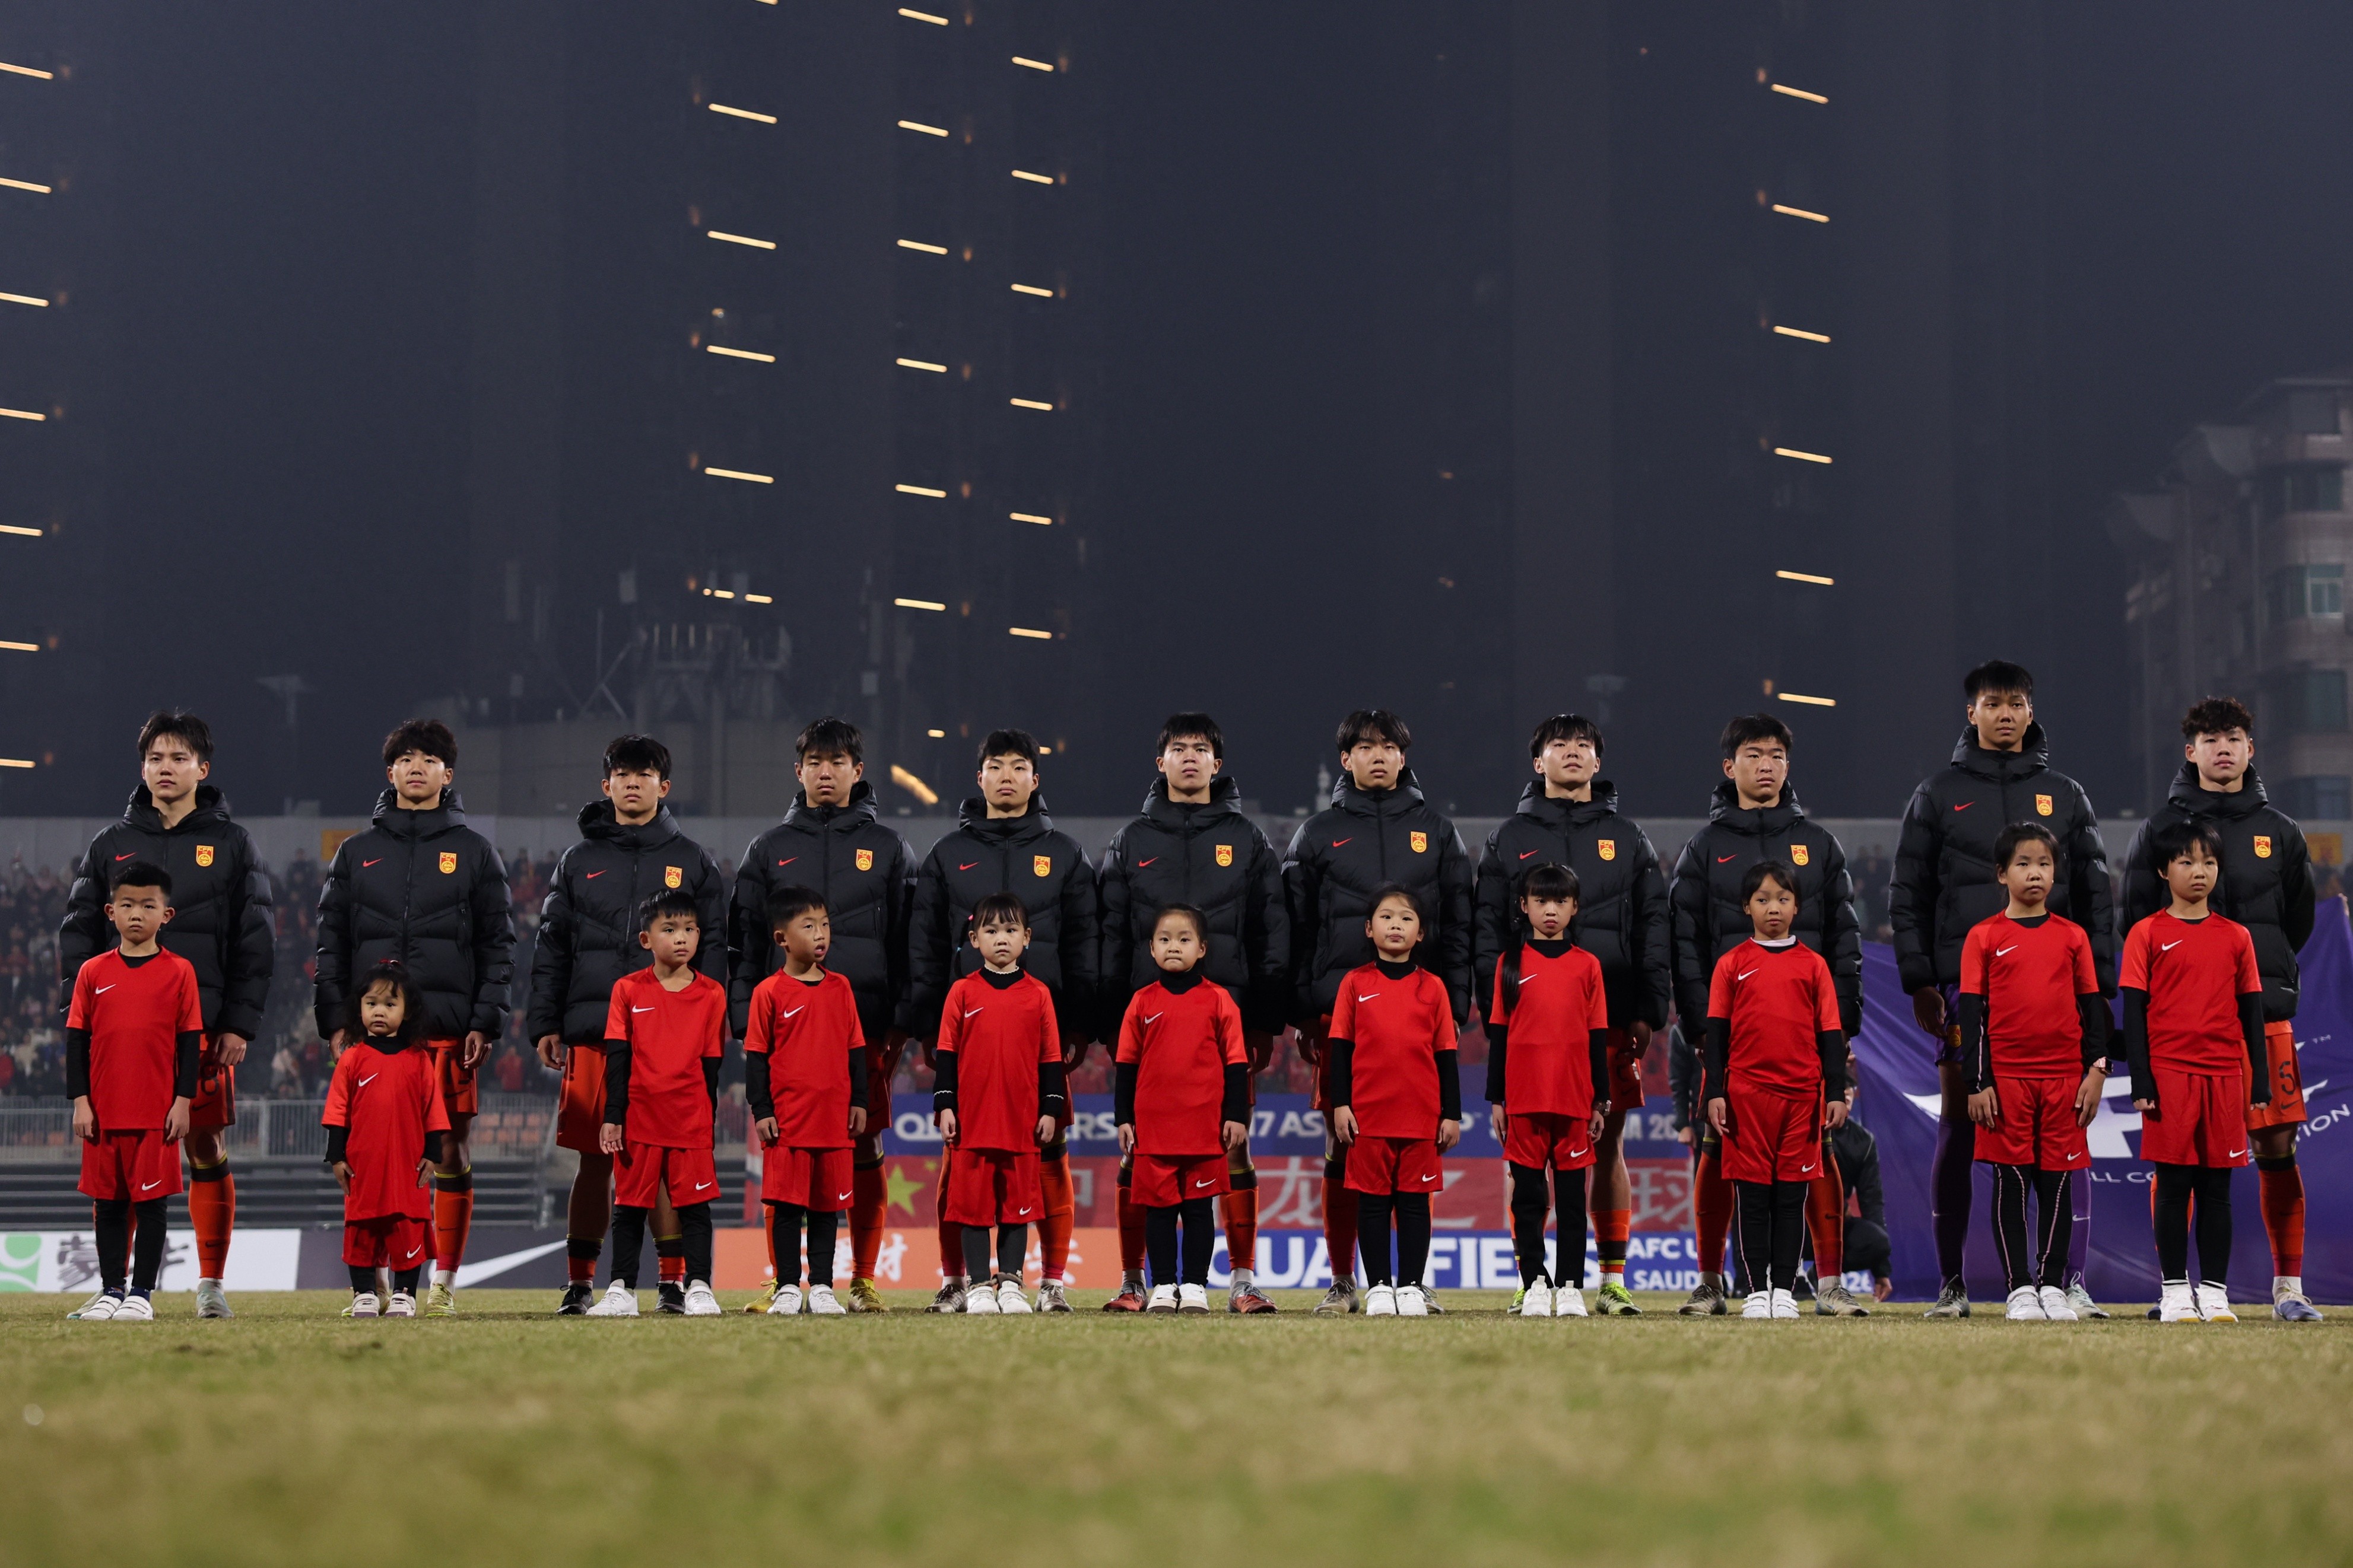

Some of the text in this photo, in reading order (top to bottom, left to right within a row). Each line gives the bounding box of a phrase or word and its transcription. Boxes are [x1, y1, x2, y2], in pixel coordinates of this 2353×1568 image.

[2279, 1060, 2296, 1096] 5
[1626, 1237, 1682, 1260] AFC
[1633, 1269, 1700, 1290] SAUD
